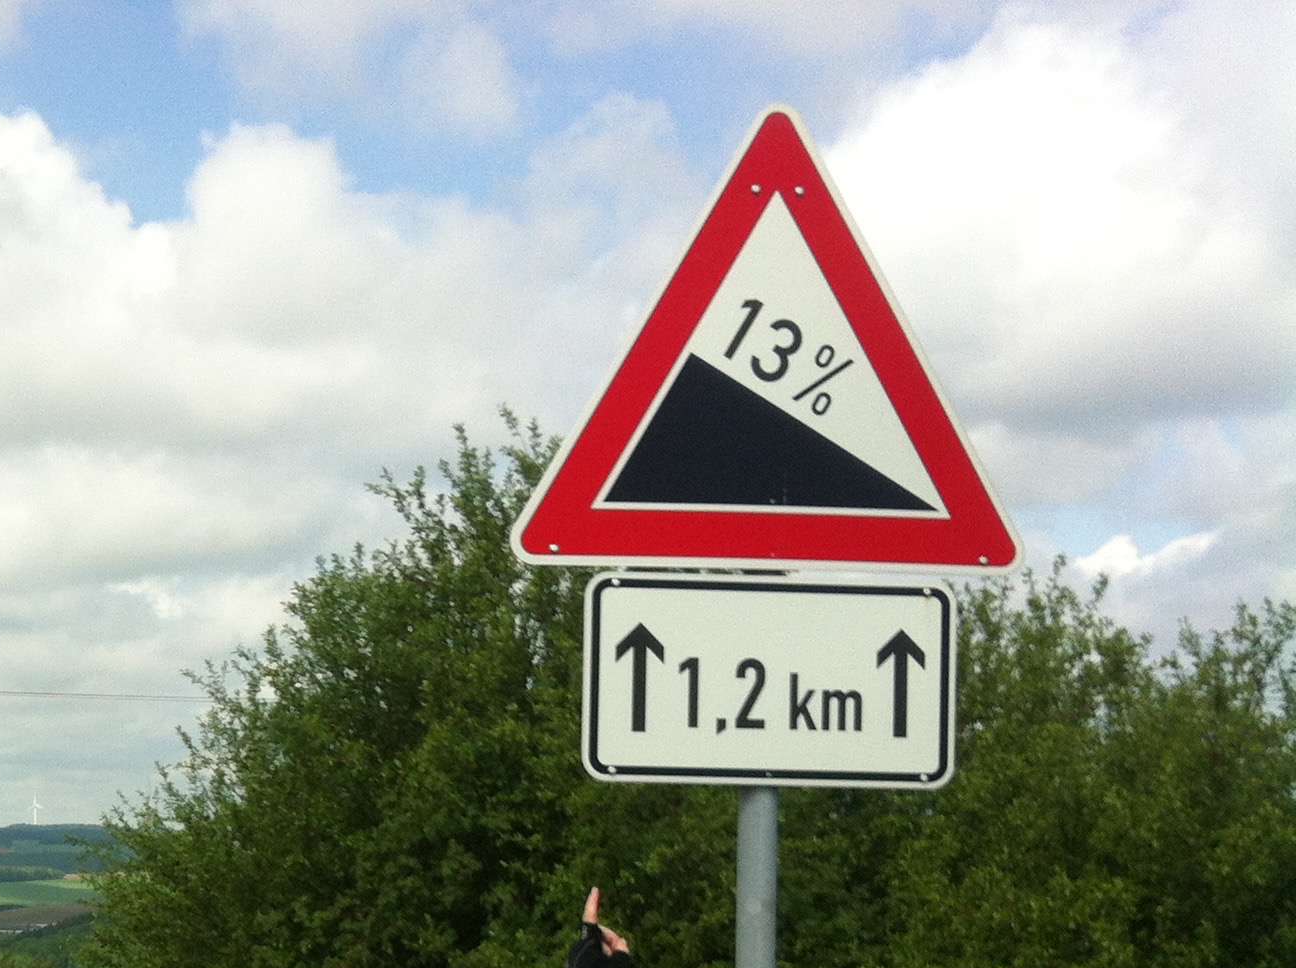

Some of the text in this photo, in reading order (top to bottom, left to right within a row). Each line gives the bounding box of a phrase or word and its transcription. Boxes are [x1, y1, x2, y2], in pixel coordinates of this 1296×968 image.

[724, 298, 855, 416] 13%
[678, 656, 863, 735] 1,2 km
